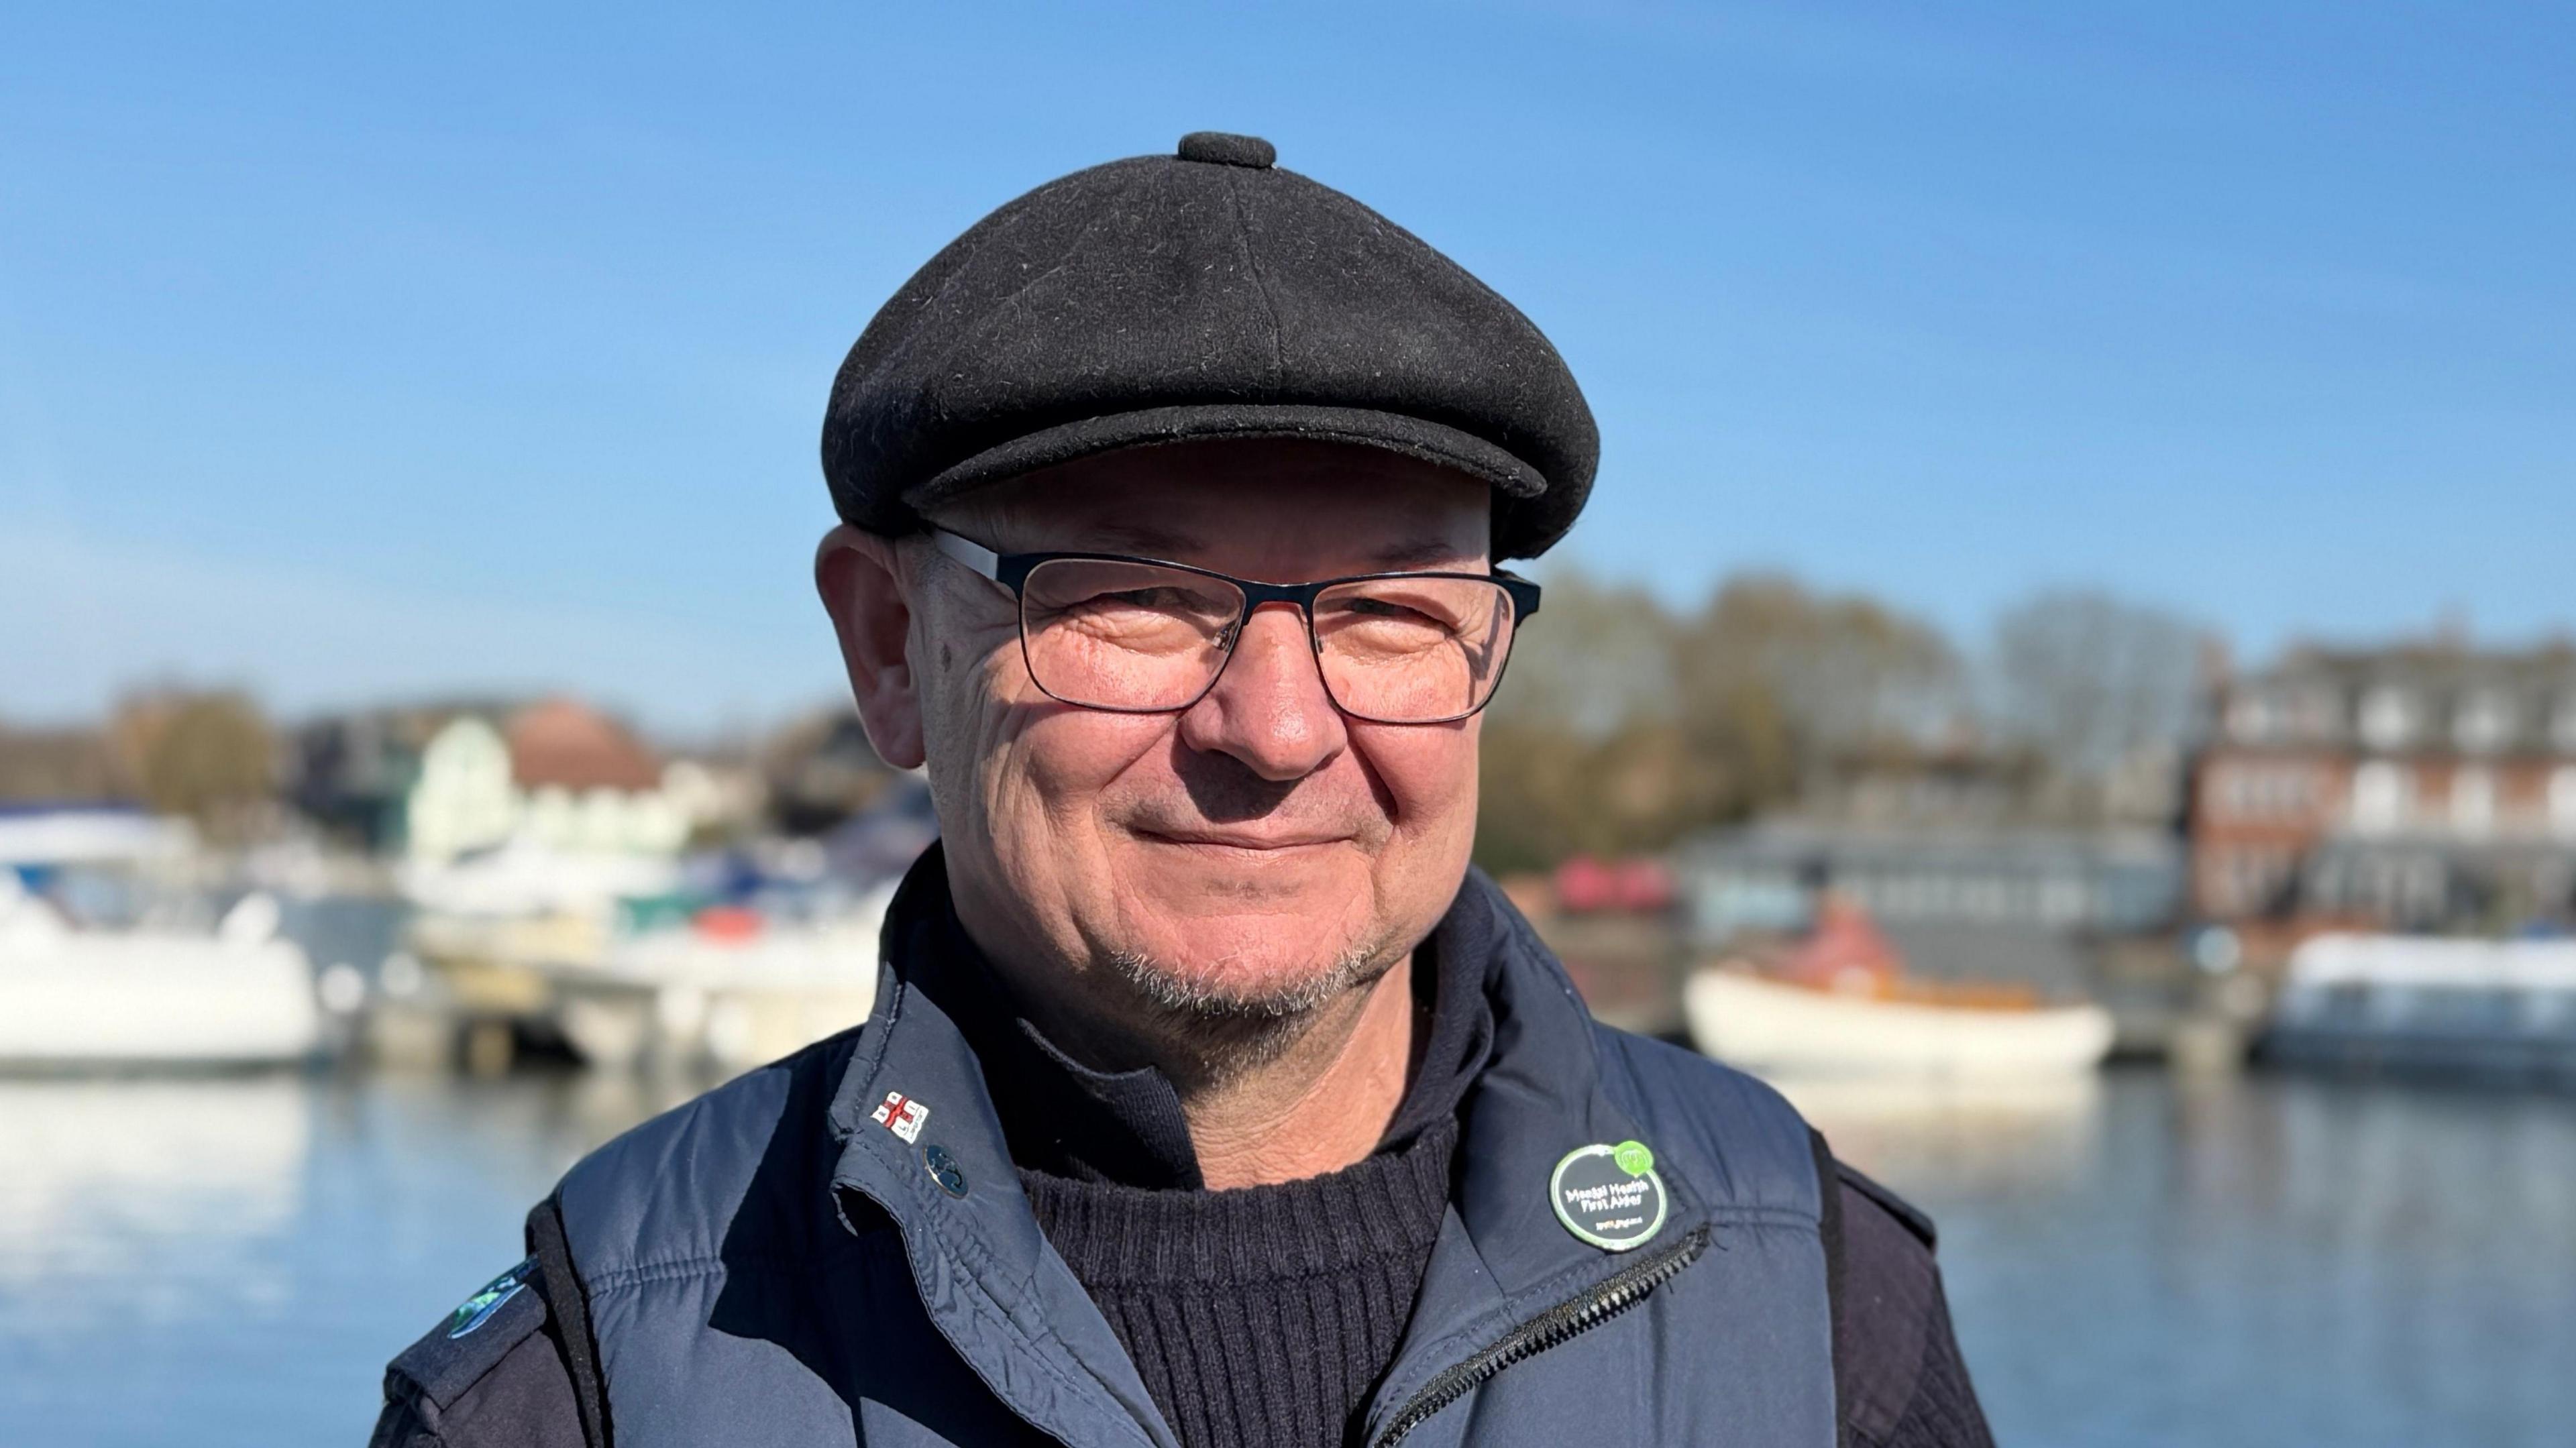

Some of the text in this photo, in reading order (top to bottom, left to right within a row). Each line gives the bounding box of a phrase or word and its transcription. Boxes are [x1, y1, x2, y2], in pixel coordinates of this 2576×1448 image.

[1565, 1179, 1650, 1203] Mental Health
[1580, 1194, 1642, 1213] First Aider
